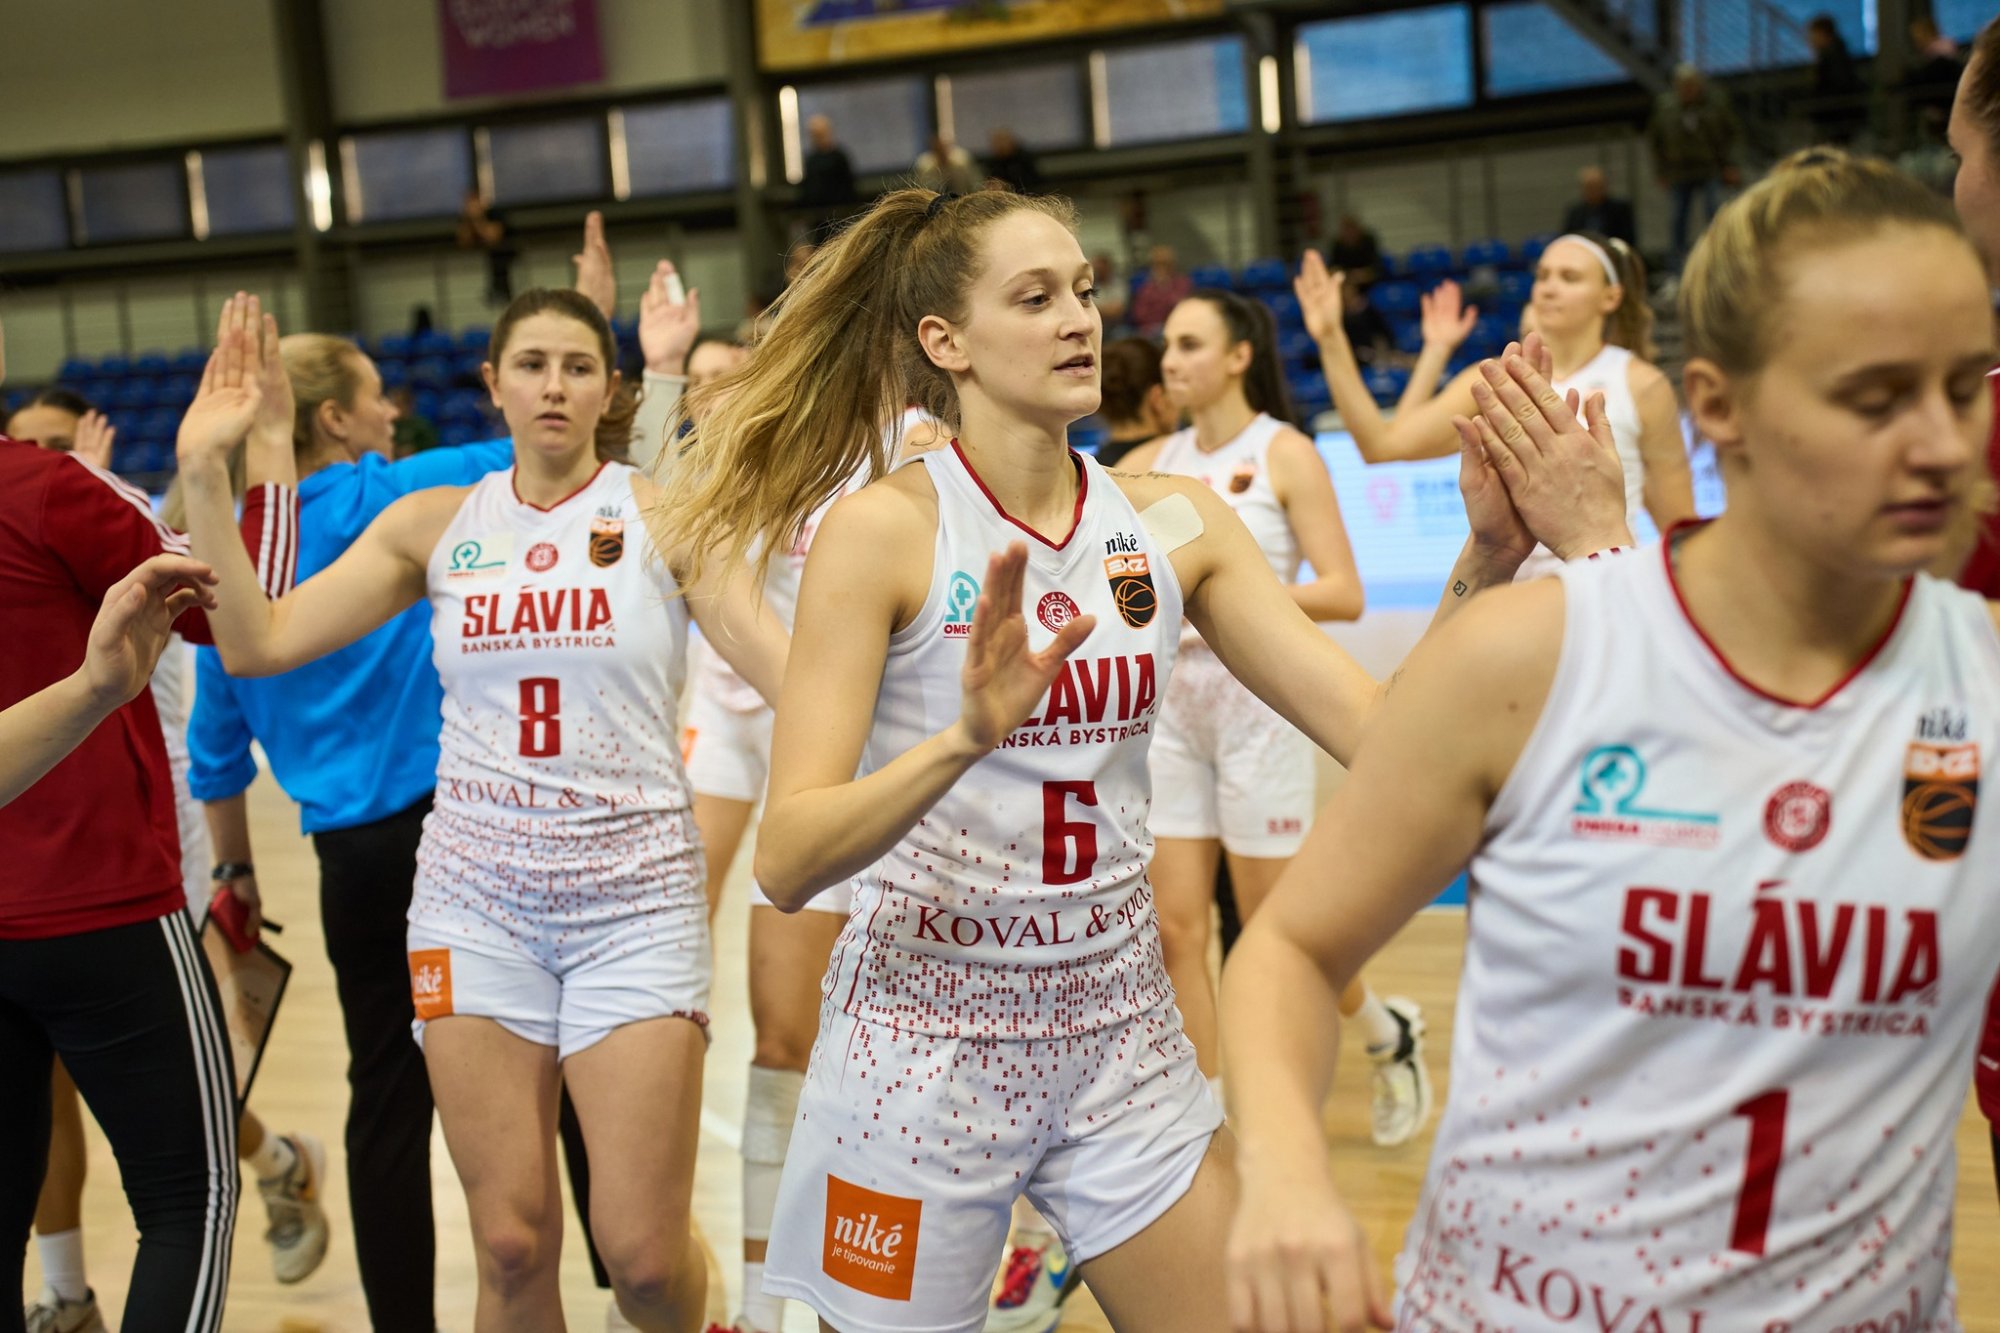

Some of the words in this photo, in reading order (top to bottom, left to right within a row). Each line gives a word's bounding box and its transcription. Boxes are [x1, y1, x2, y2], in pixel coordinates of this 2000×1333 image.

[1105, 531, 1139, 555] niké
[462, 584, 613, 638] SLÁVIA
[943, 623, 974, 635] OME
[461, 636, 526, 654] BANSKÁ
[533, 635, 616, 649] BYSTRICA
[518, 677, 562, 758] 8
[995, 727, 1062, 750] NSKÁ
[1070, 720, 1149, 745] BYSTRICA
[450, 778, 547, 809] KOVAL
[557, 787, 583, 809] &
[1042, 780, 1098, 885] 6
[912, 905, 1076, 948] KOVAL
[1085, 904, 1112, 938] &
[1616, 880, 1941, 1008] SLÁVIA
[1616, 987, 1759, 1028] BANSKÁ
[1772, 1005, 1929, 1038] BYSTRICA
[1730, 1087, 1789, 1258] 1
[833, 1213, 904, 1258] niké
[831, 1243, 842, 1257] je
[843, 1249, 896, 1274] tipovanie
